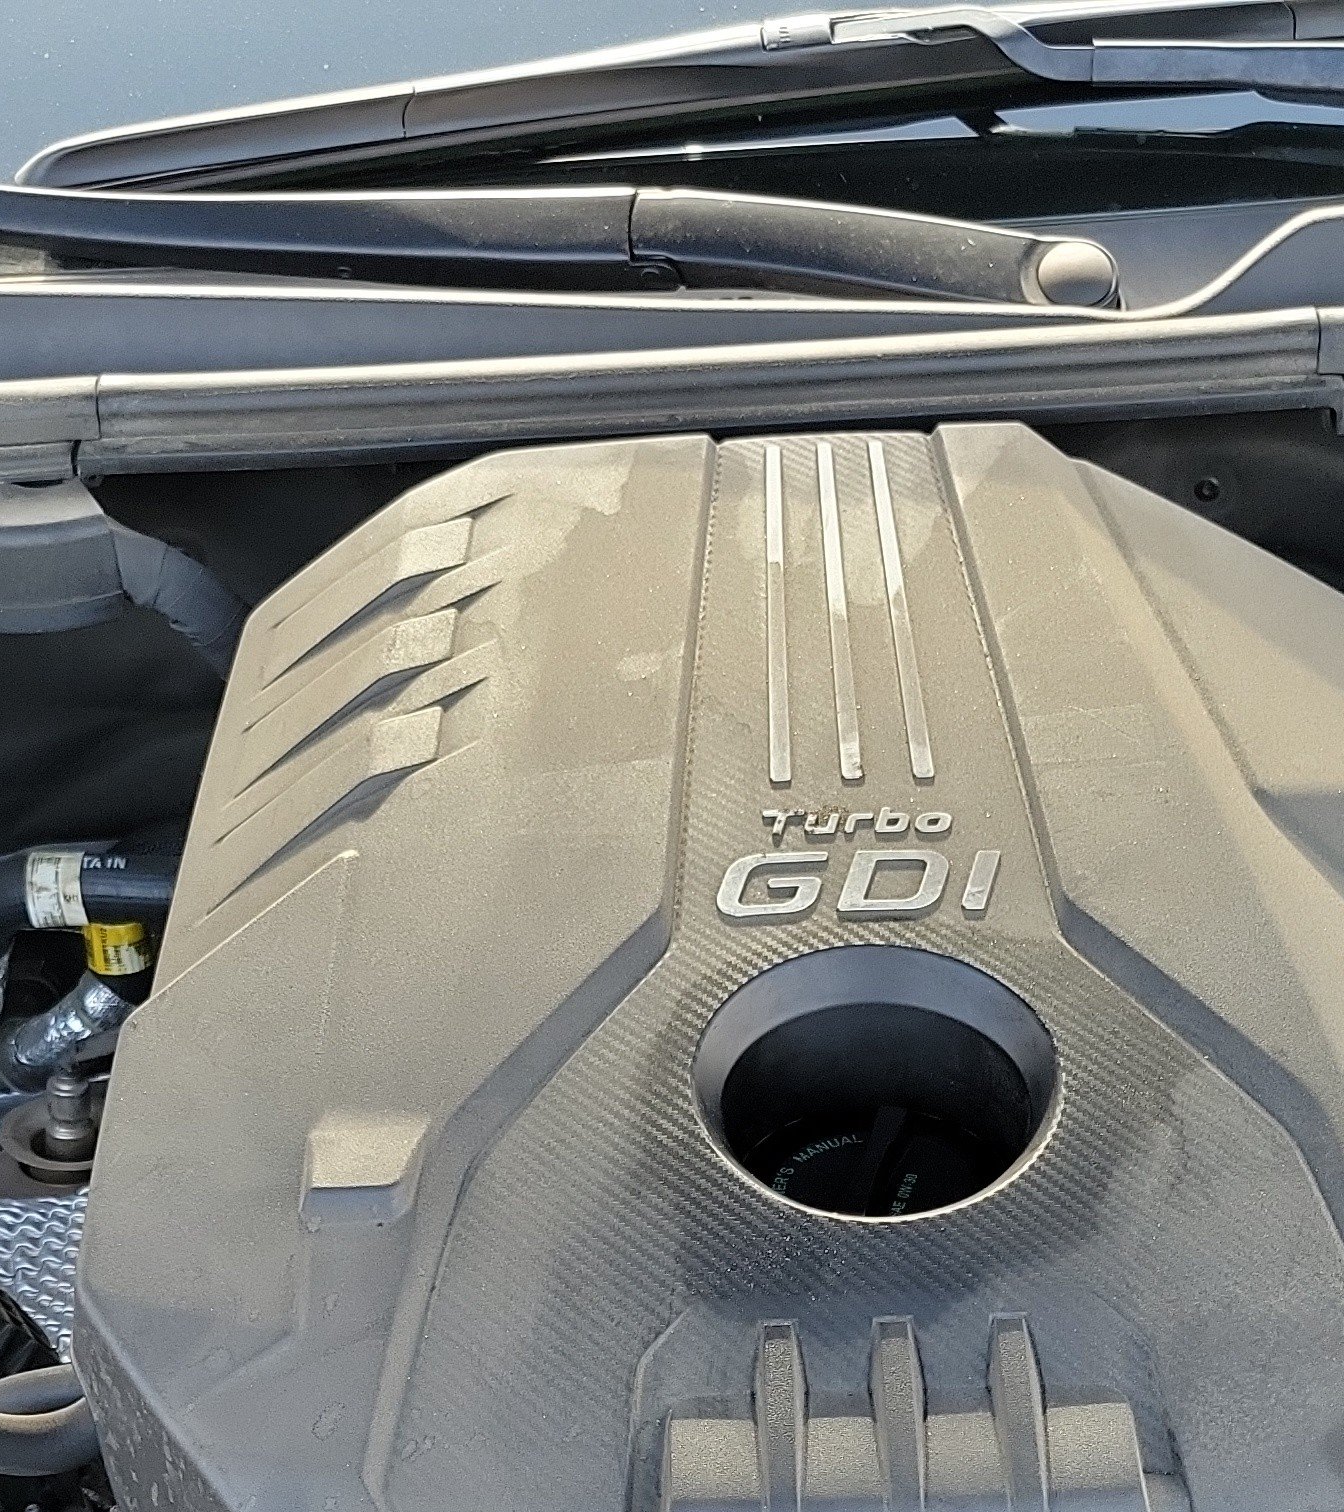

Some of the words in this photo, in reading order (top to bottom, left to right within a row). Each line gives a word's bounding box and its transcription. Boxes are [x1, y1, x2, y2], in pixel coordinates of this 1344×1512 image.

[762, 806, 953, 837] Turbo
[715, 850, 1001, 918] GDI
[792, 1134, 864, 1163] MANUAL
